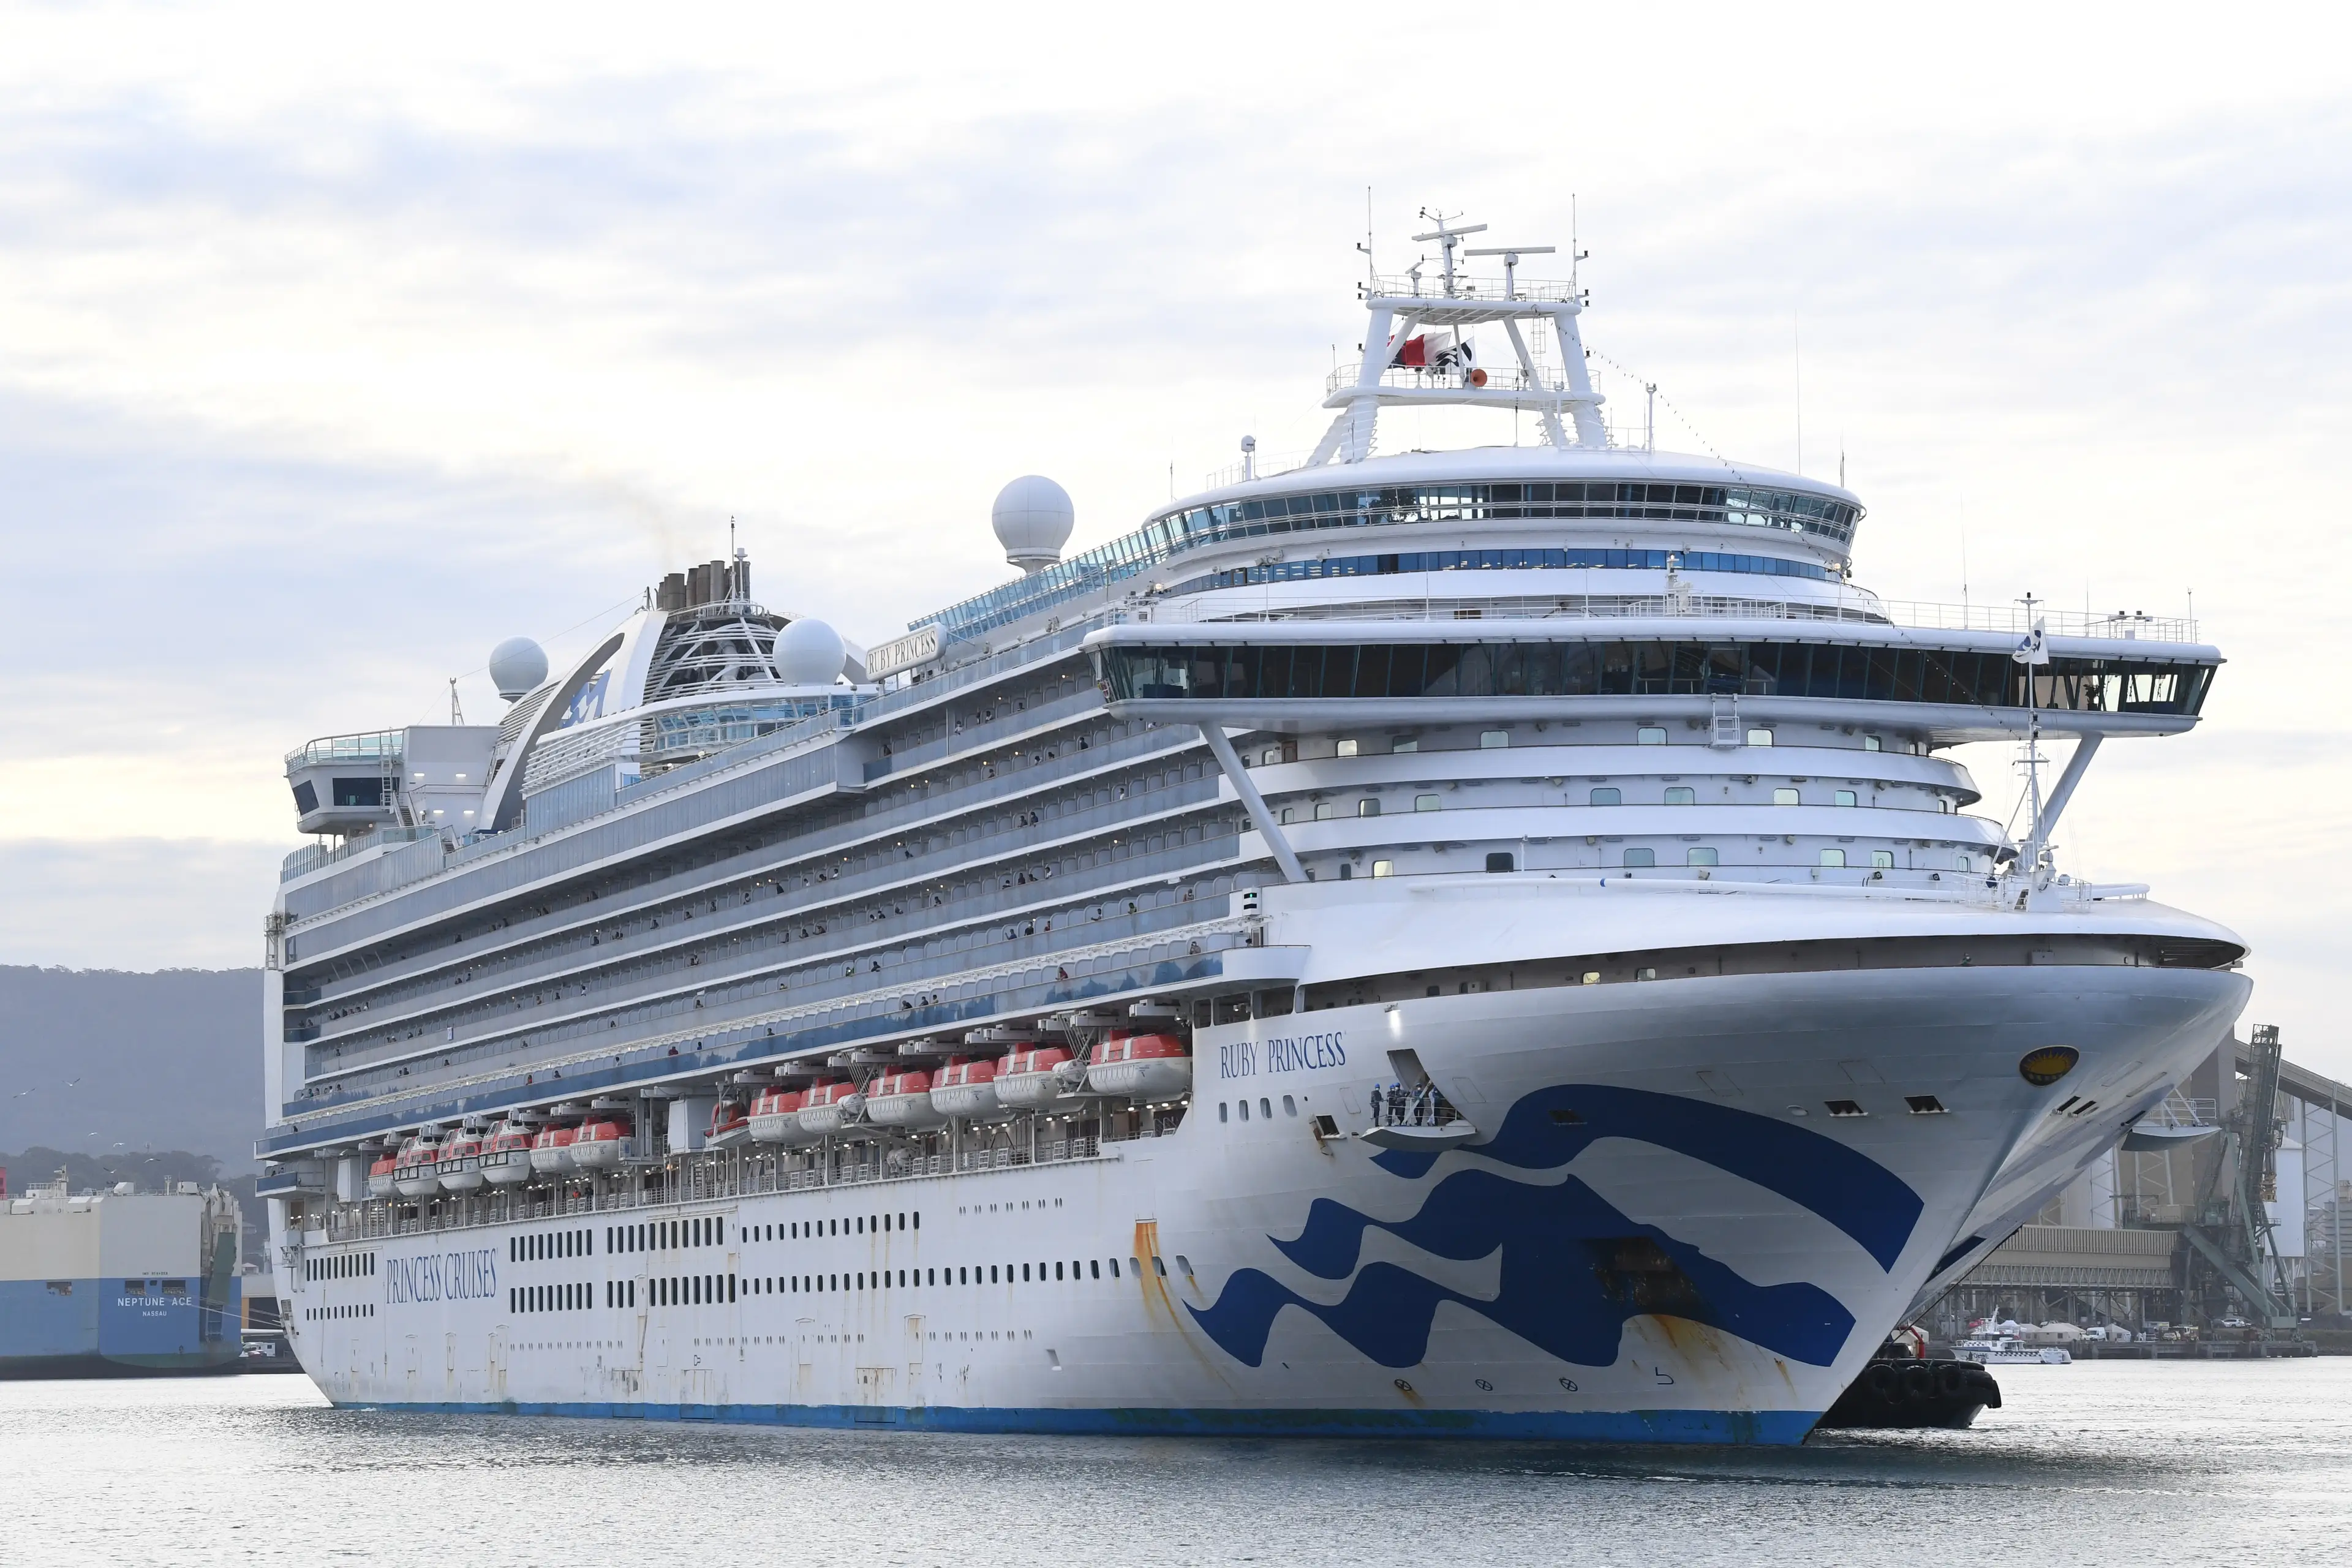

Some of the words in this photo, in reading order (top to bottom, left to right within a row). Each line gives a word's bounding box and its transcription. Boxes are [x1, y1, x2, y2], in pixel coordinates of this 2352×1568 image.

[869, 647, 891, 674] RUBY
[894, 631, 936, 665] PRINCESS
[1220, 1042, 1259, 1079] RUBY
[1267, 1031, 1346, 1072] PRINCESS
[386, 1254, 441, 1304] PRINCESS
[445, 1248, 497, 1300] CRUISES
[118, 1297, 165, 1306] NEPTUNE
[172, 1297, 192, 1306] ACE
